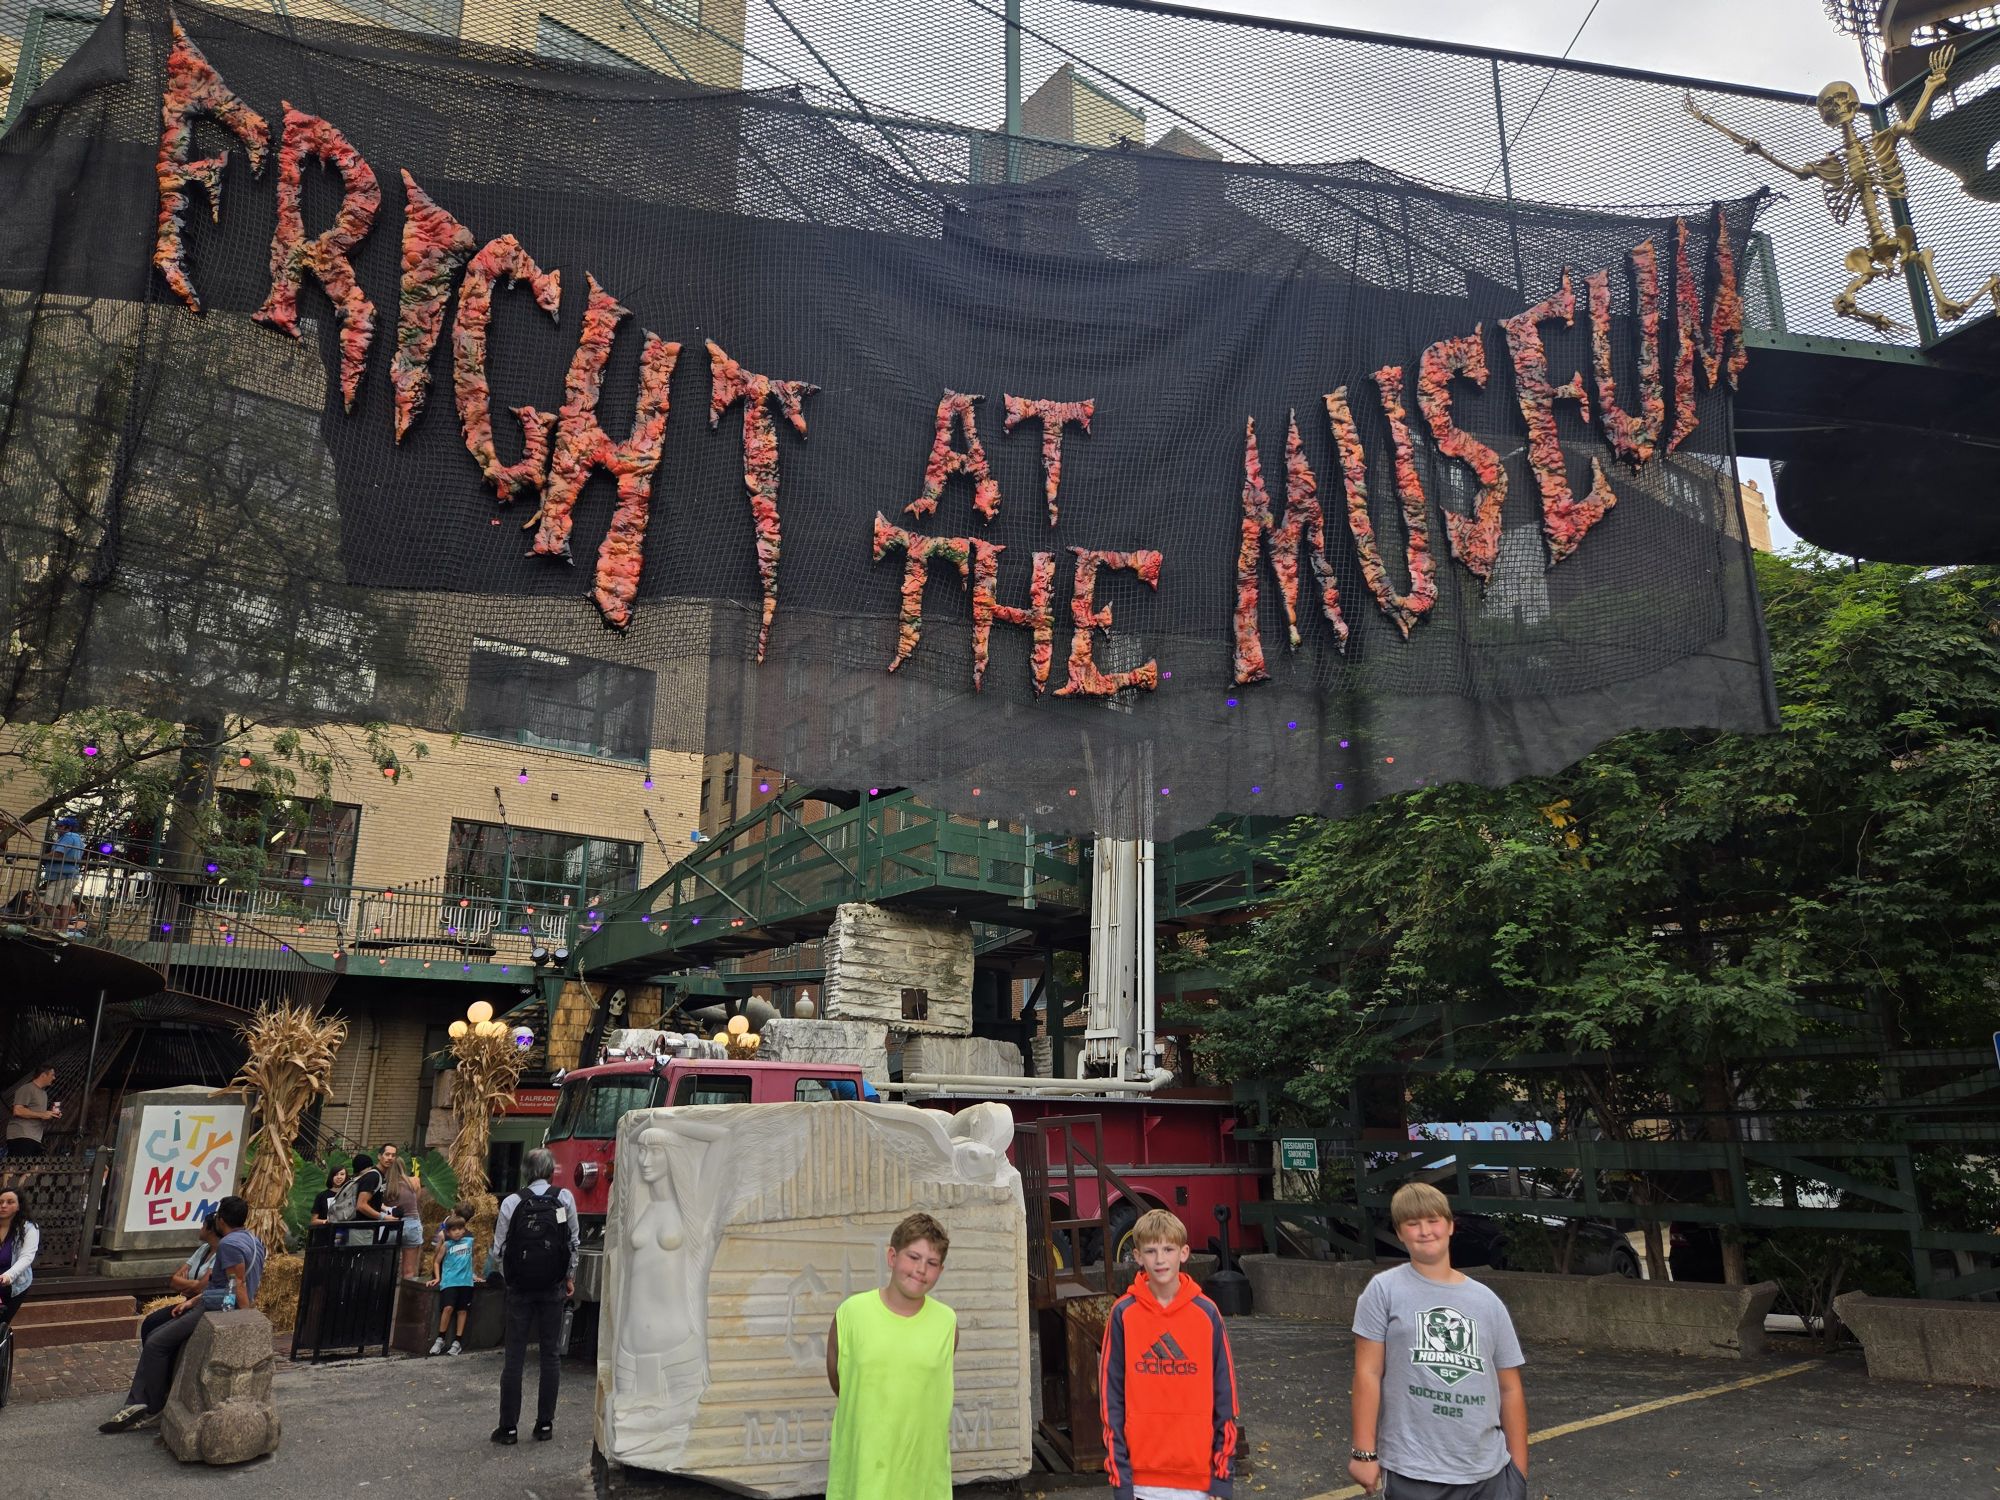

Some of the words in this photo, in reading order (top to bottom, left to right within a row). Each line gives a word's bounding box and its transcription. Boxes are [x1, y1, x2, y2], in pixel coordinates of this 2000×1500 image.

[153, 16, 821, 665] FRIGHT
[904, 387, 1095, 528] AT
[1230, 206, 1748, 690] MUSEUM
[873, 510, 1163, 702] THE
[1284, 1142, 1313, 1150] DESIGNATED
[1292, 1159, 1307, 1167] AREA
[144, 1156, 230, 1196] MUS
[1135, 1358, 1198, 1376] adidas
[1418, 1351, 1479, 1370] HORNETS
[1440, 1368, 1459, 1379] SC
[1408, 1384, 1452, 1403] SOCCER
[1455, 1394, 1486, 1406] CAMP
[1432, 1404, 1464, 1418] 2025
